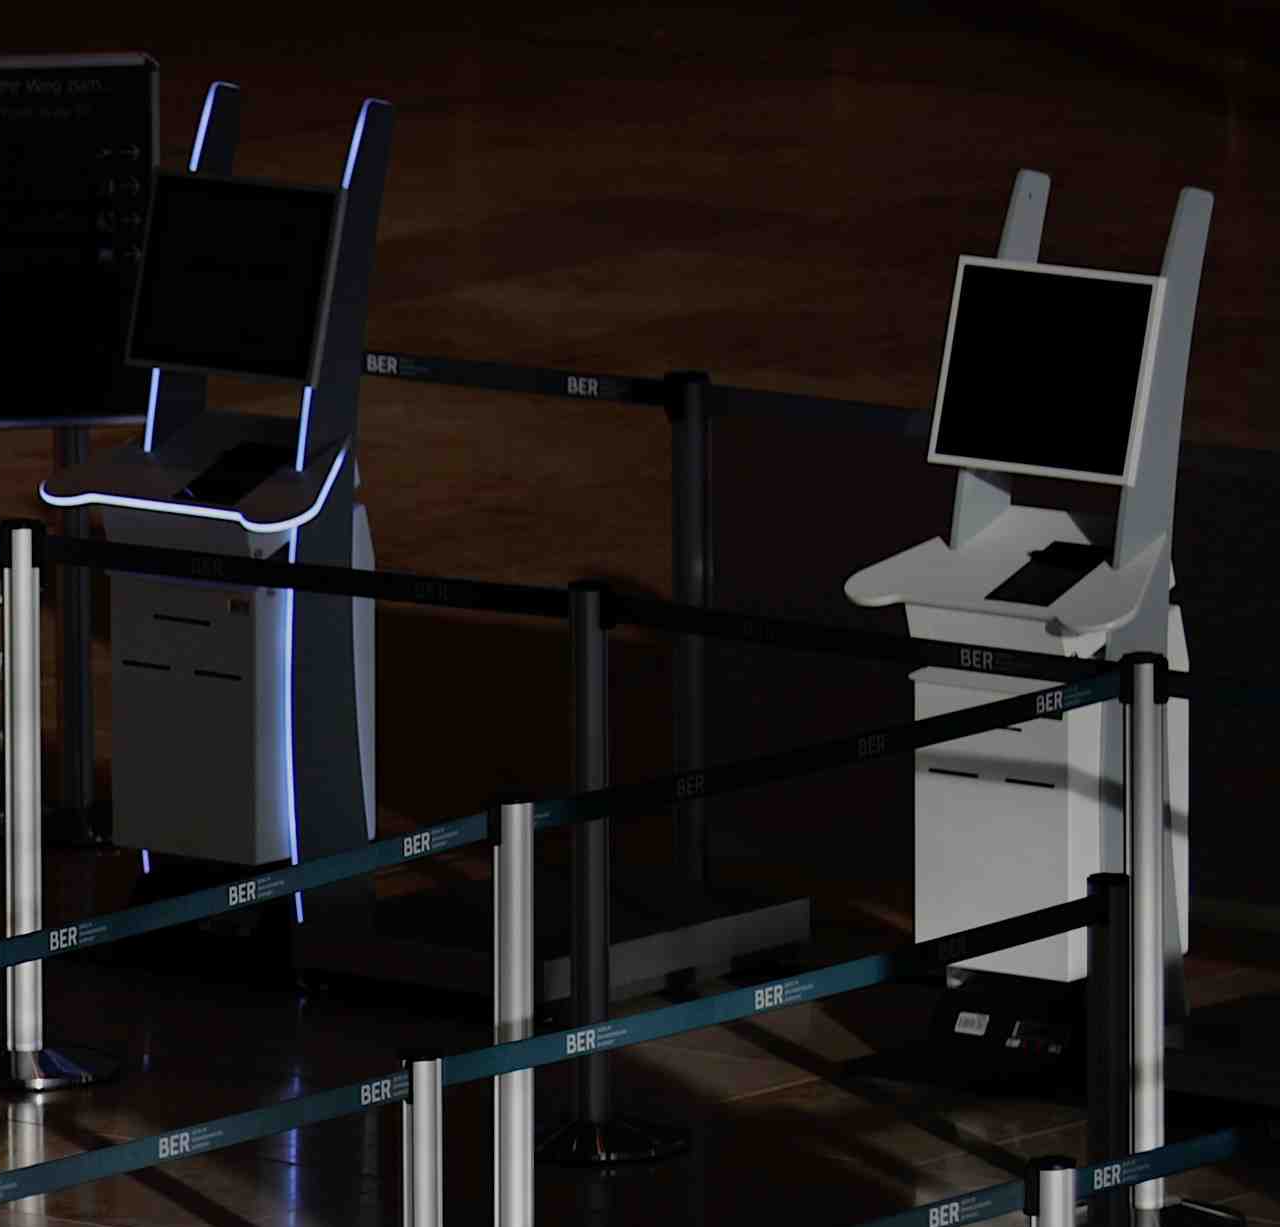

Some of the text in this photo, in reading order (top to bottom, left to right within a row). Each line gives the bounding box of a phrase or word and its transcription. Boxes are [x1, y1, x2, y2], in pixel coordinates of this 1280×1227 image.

[365, 352, 398, 376] BER
[566, 375, 599, 398] BER
[960, 649, 994, 670] BER
[1035, 692, 1063, 714] BER
[403, 833, 430, 857] BER
[229, 881, 256, 905] BER
[49, 925, 77, 951] BER
[755, 986, 784, 1007] BER
[566, 1029, 596, 1054] BER
[361, 1077, 392, 1105] BER
[159, 1133, 190, 1157] BER
[1093, 1164, 1121, 1189] BER
[929, 1202, 959, 1227] BER
